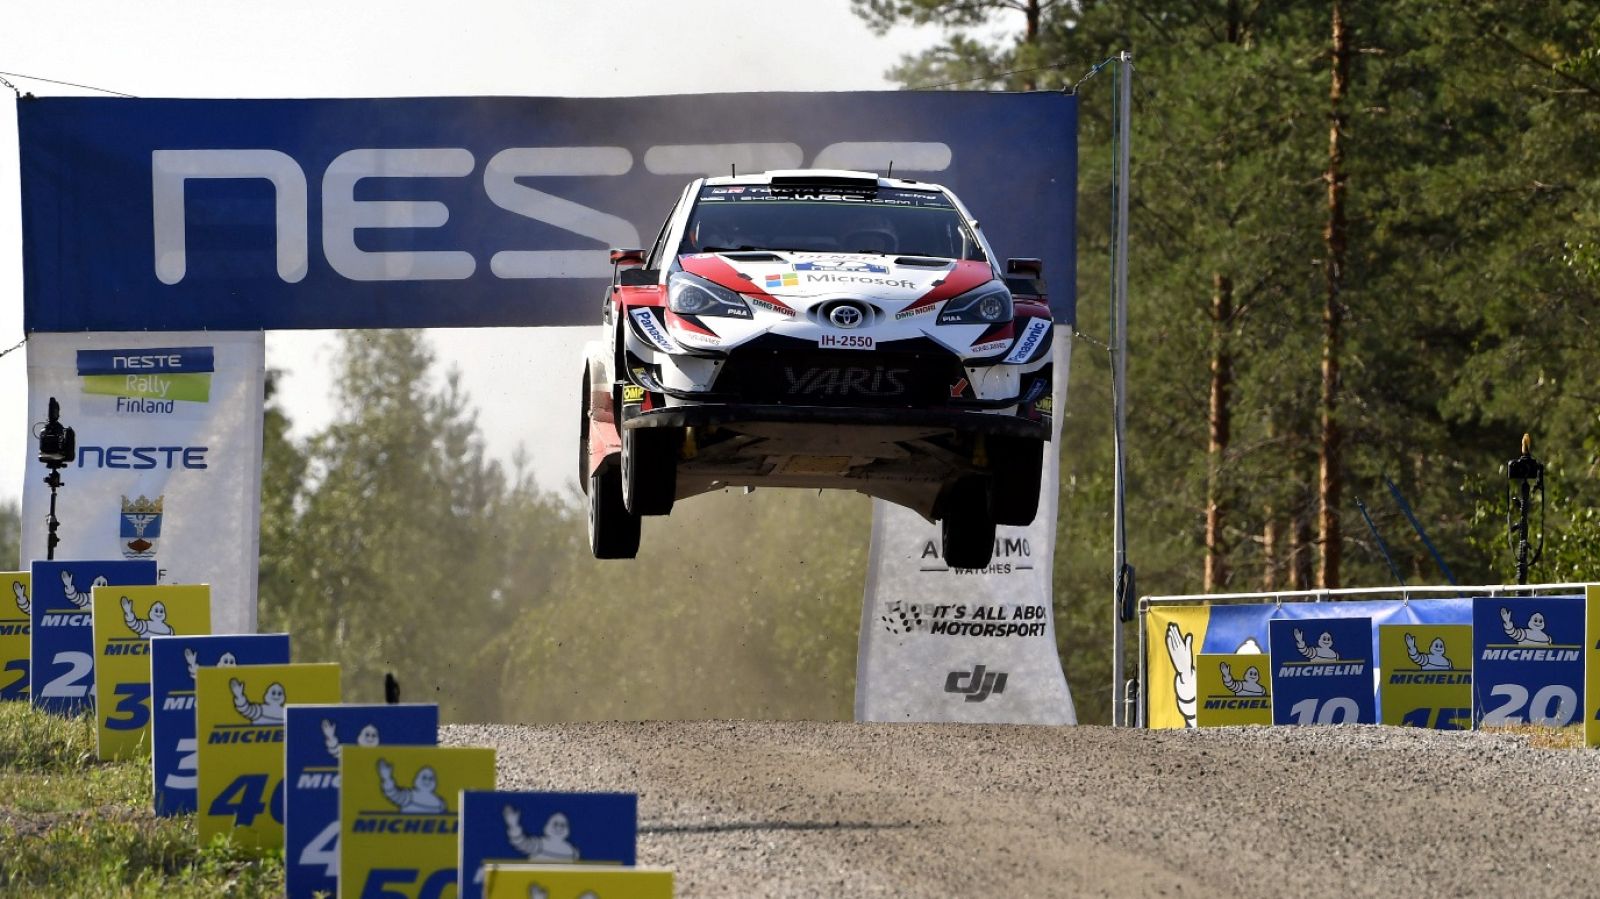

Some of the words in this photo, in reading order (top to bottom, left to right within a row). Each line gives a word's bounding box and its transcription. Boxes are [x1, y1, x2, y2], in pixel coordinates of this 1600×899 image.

[152, 142, 952, 285] NES
[806, 274, 917, 290] Microsoft
[727, 308, 748, 316] PIAA
[752, 298, 773, 310] DMG
[772, 304, 797, 317] MORI
[821, 334, 873, 348] IH-2550
[113, 354, 182, 369] NESTE
[126, 374, 171, 397] Rally
[116, 396, 174, 414] Finland
[78, 446, 209, 470] NESTE
[41, 614, 92, 627] MICH
[932, 604, 966, 619] IT'S
[971, 605, 1007, 621] ALL
[930, 621, 1046, 637] MOTORSPORT
[1481, 648, 1580, 662] MICHELIN
[41, 651, 96, 697] 2
[1278, 663, 1365, 678] MICHELIN
[1389, 673, 1473, 685] MICHELIN
[104, 683, 151, 731] 3
[1203, 699, 1271, 710] MICHEL
[1288, 697, 1361, 726] 10
[1480, 683, 1578, 727] 20
[207, 728, 284, 745] MICHE
[207, 773, 284, 828] 4
[352, 818, 459, 834] MICHELI
